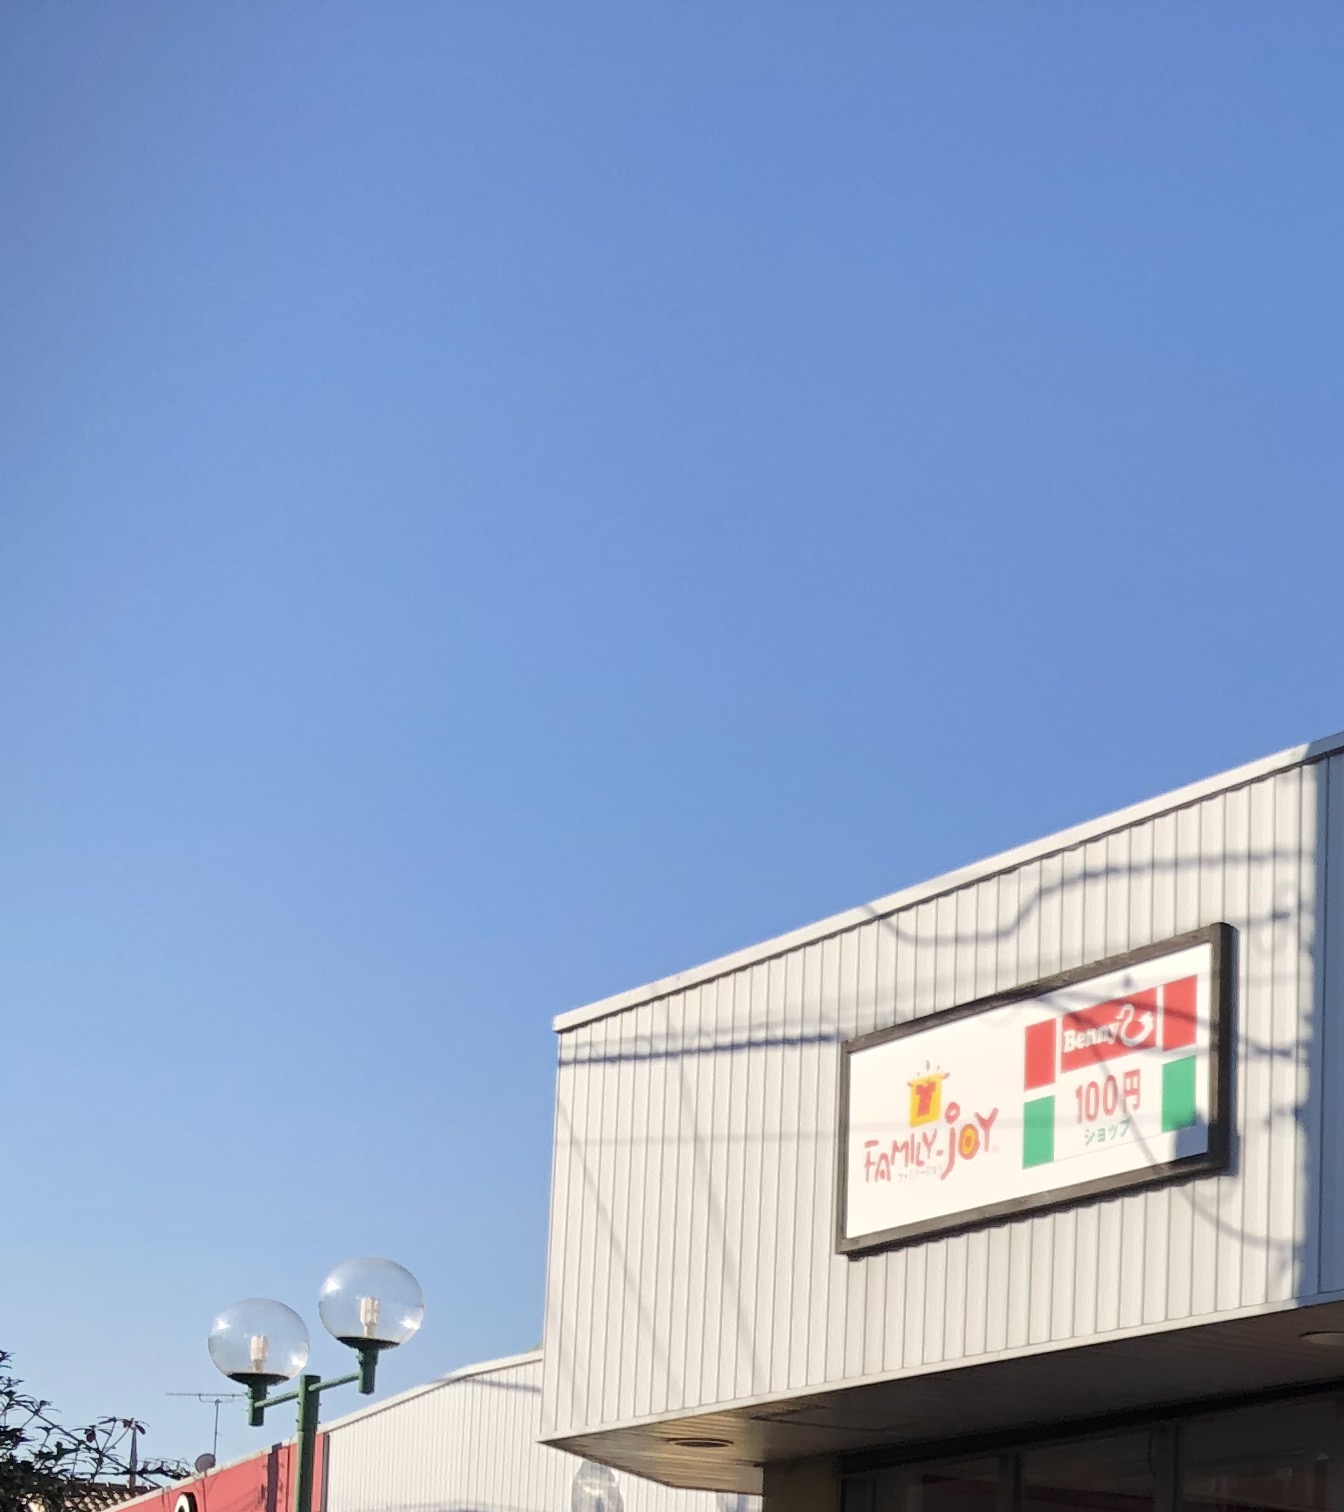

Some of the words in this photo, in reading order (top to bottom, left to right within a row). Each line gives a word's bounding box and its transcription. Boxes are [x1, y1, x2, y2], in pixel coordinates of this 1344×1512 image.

[1063, 1020, 1120, 1053] Benny
[1076, 1069, 1141, 1125] 100円
[1084, 1114, 1133, 1146] ショップ
